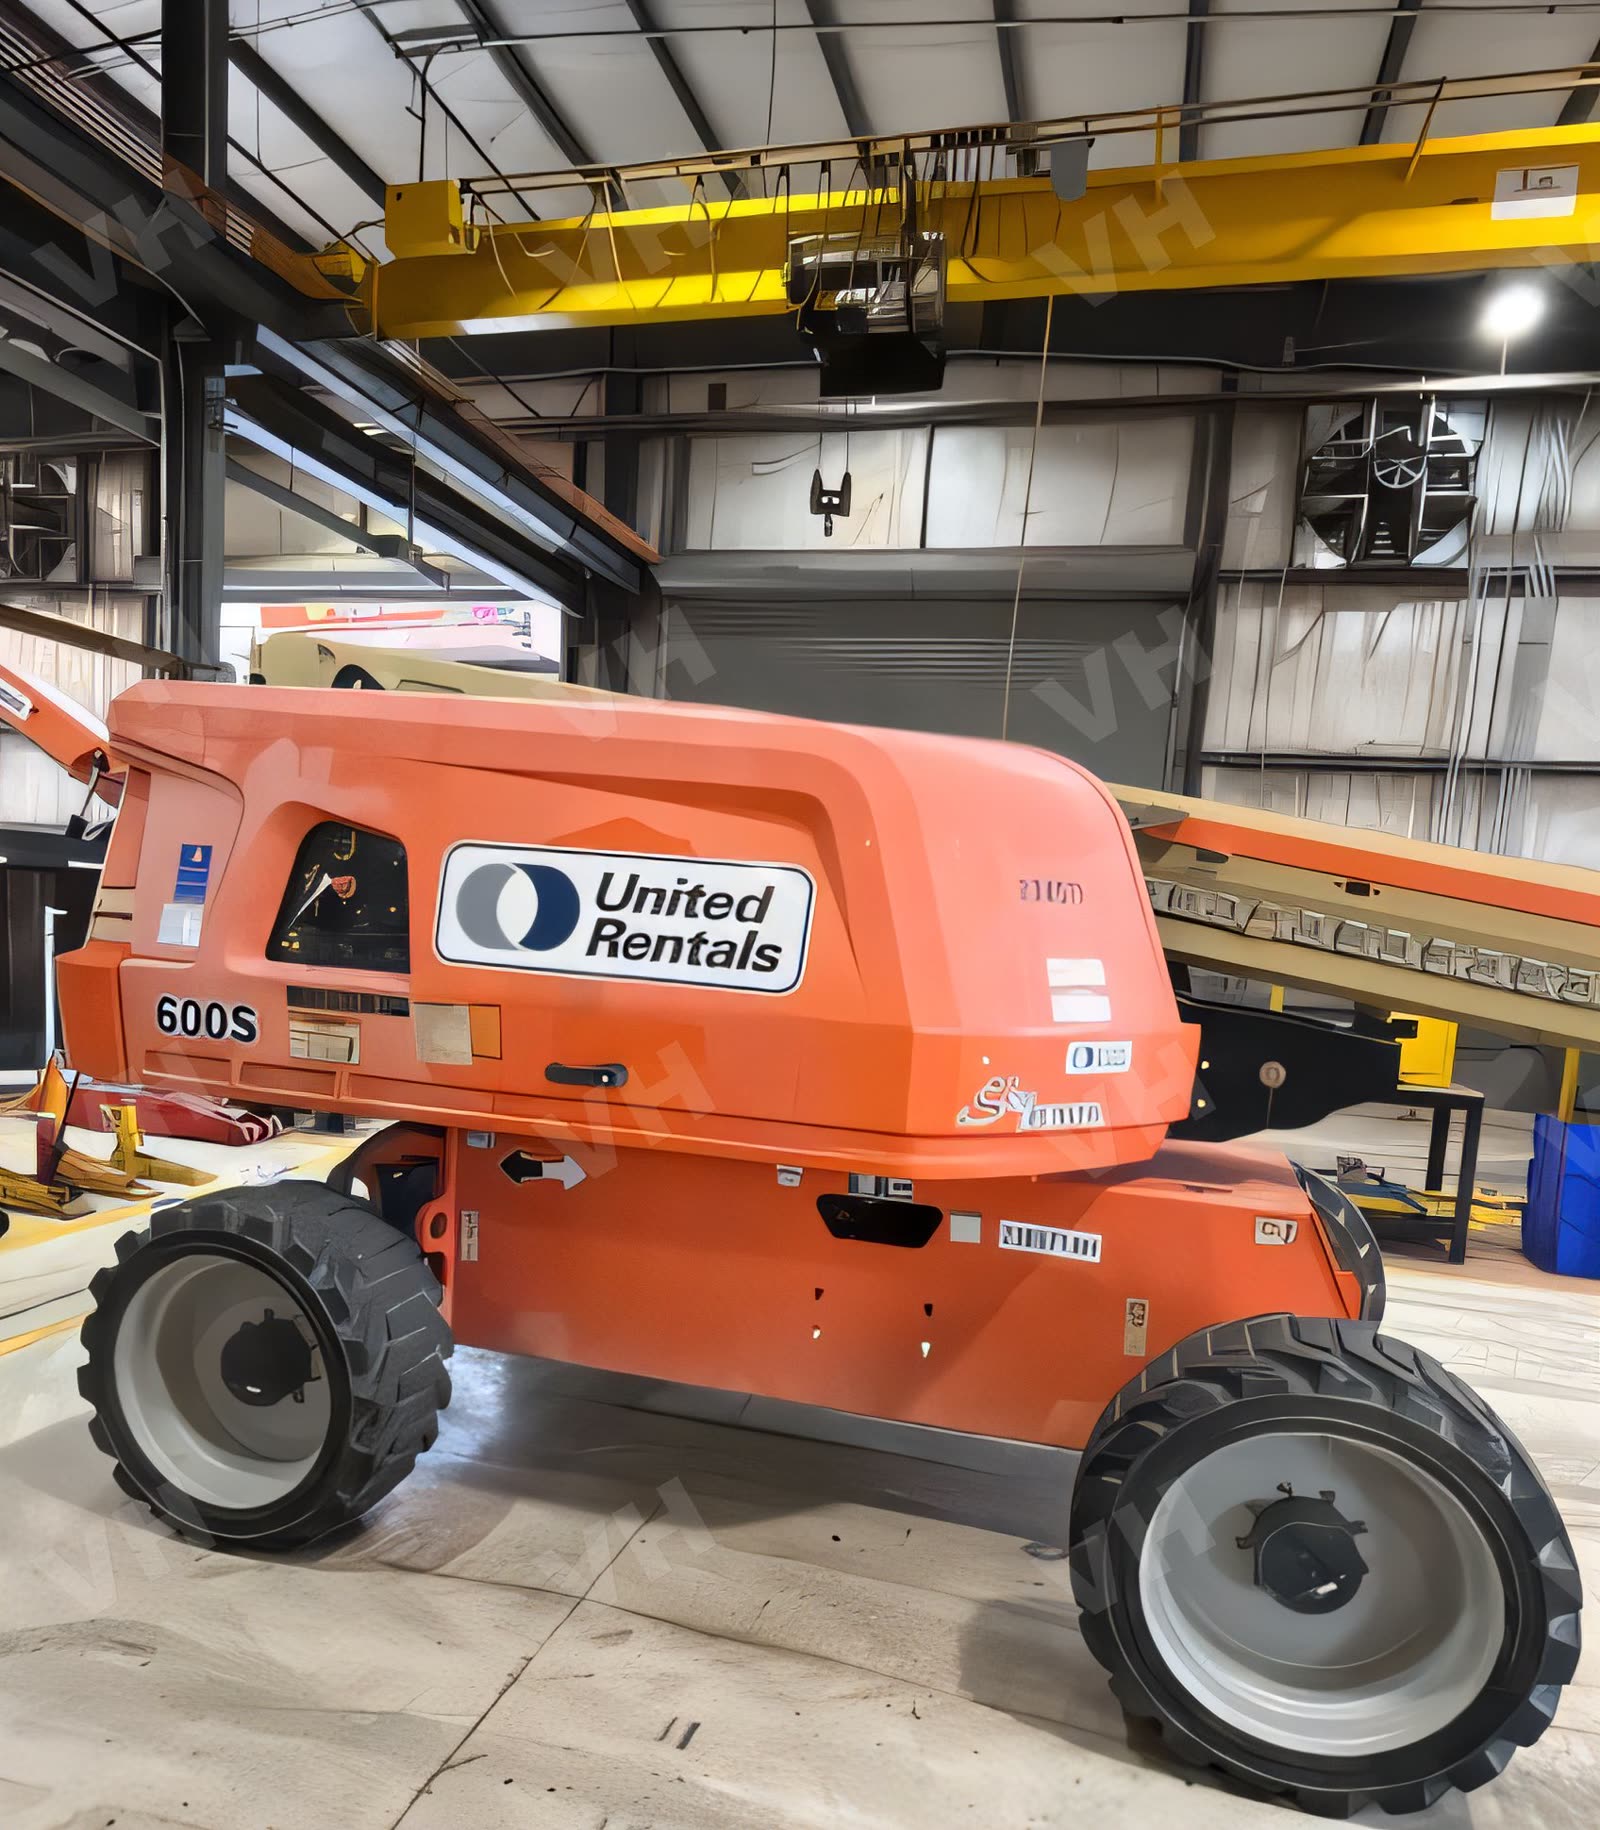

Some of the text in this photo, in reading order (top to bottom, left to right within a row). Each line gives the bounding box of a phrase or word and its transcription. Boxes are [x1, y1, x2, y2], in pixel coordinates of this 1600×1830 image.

[596, 872, 775, 923] United
[586, 918, 782, 972] Rentals
[157, 995, 257, 1043] 600S
